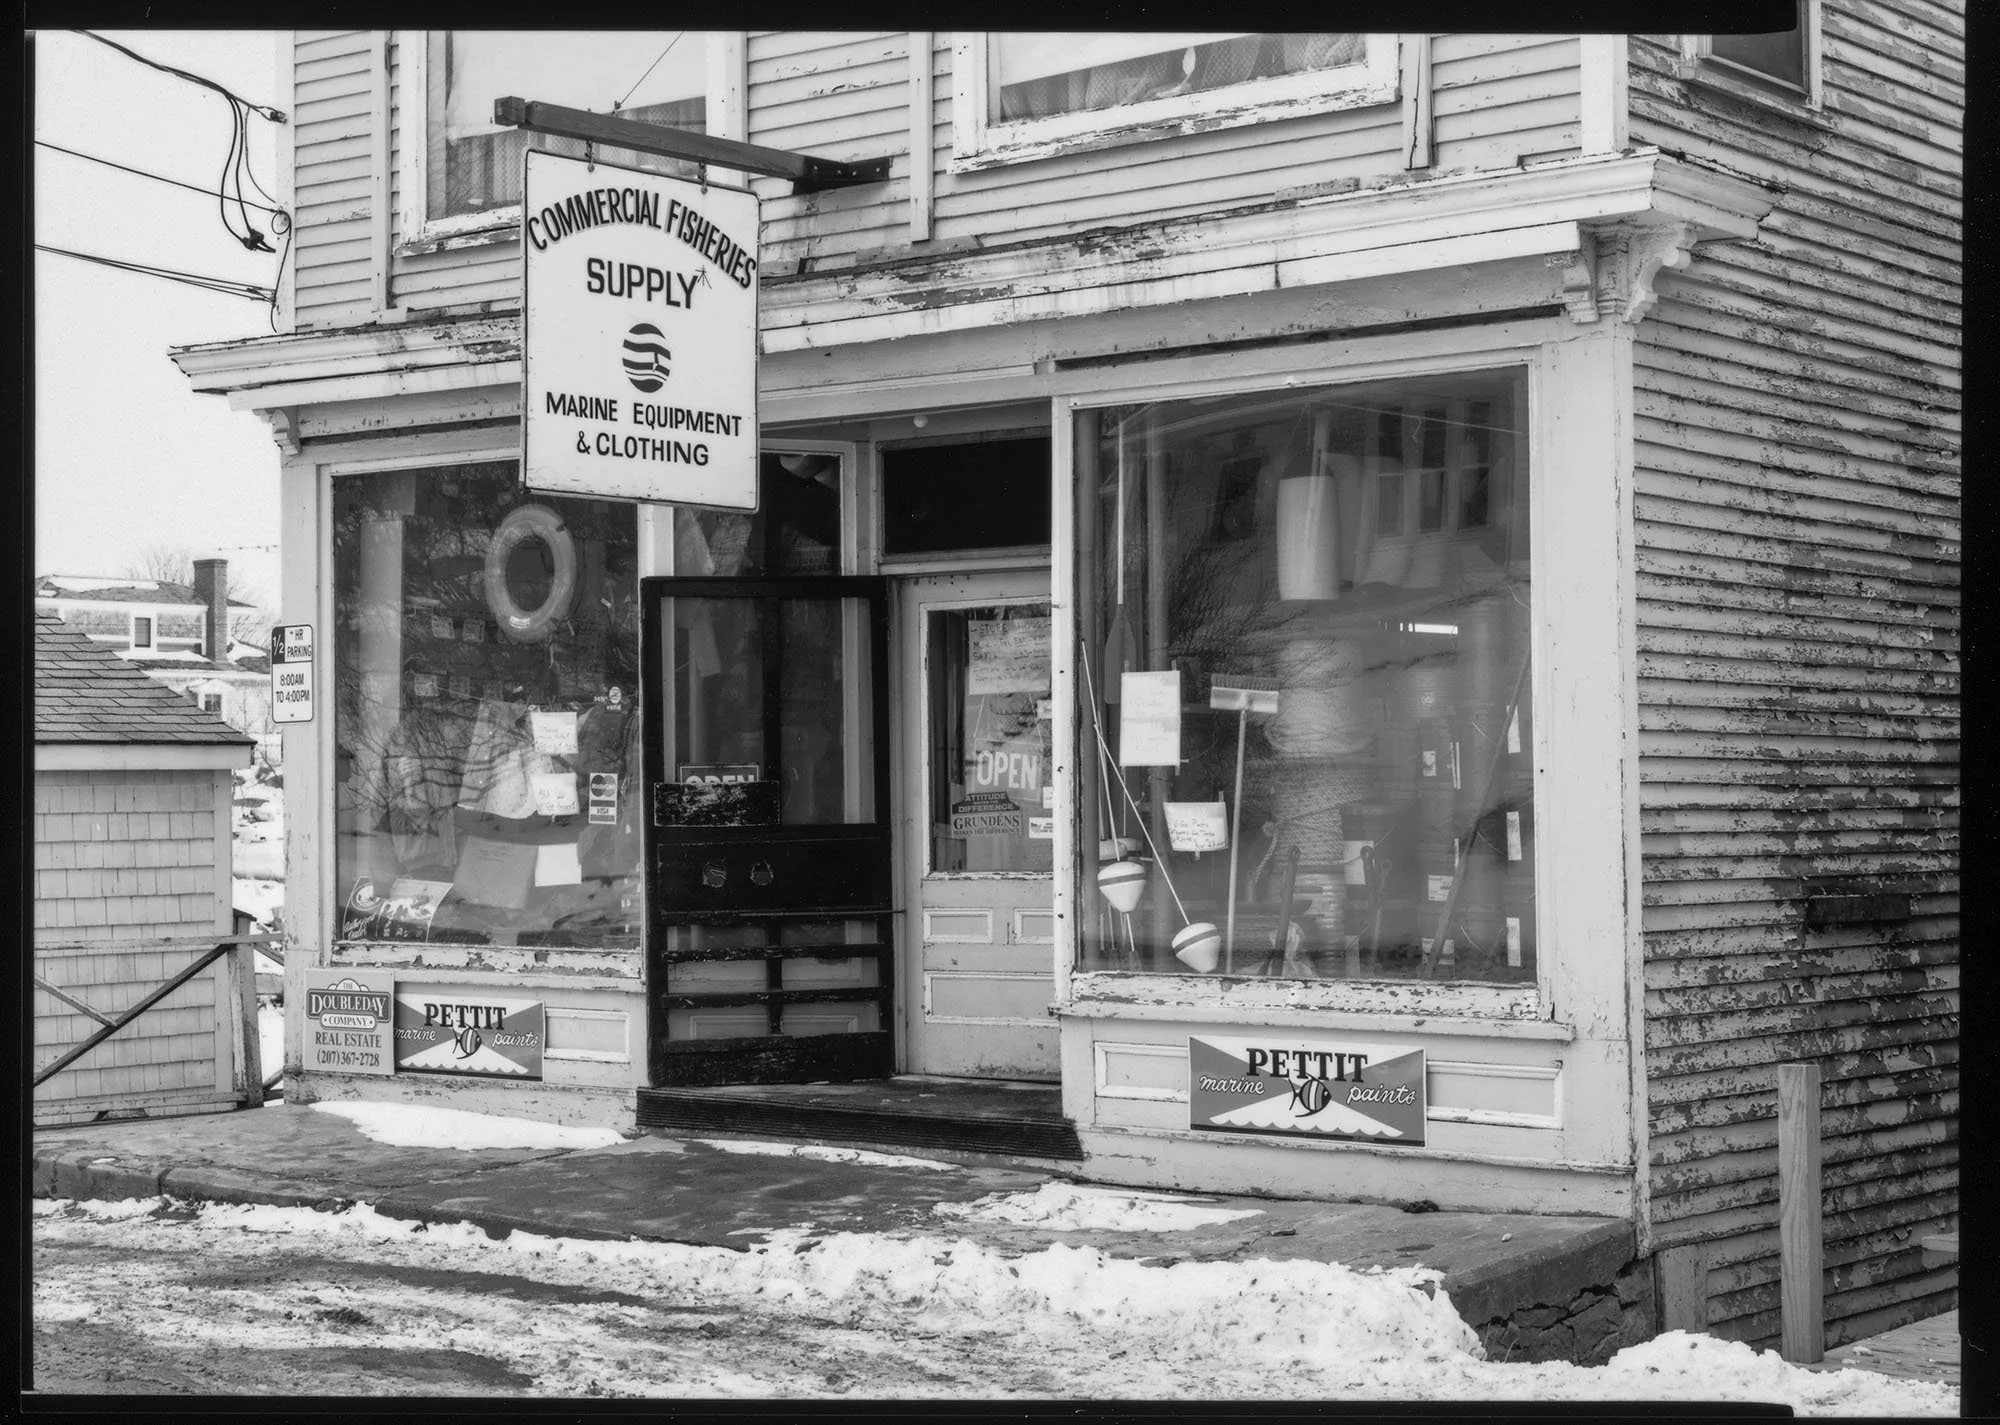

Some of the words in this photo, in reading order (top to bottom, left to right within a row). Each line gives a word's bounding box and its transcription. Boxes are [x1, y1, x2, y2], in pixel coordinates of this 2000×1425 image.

[528, 187, 662, 251] COMMERCIAL
[665, 199, 757, 290] FISHERIES
[587, 258, 699, 309] SUPPLY
[546, 391, 618, 422] MARINE
[633, 403, 742, 437] EQUIPMENT
[576, 430, 591, 455] &
[596, 432, 709, 467] CLOTHING
[294, 628, 304, 641] HR
[287, 645, 312, 657] PARKING
[276, 691, 284, 703] TO
[977, 751, 1038, 791] OPEN
[958, 803, 1014, 813] DIFFERENCE
[964, 792, 1008, 802] ATTITUDE
[310, 994, 386, 1018] DOUBLEDAY
[424, 1003, 507, 1030] PETTIT
[329, 1016, 368, 1026] COMPANY
[315, 1031, 342, 1046] REAL
[344, 1033, 382, 1049] ESTATE
[394, 1026, 437, 1042] marine
[492, 1031, 539, 1048] paints
[1246, 1048, 1368, 1083] PETTIT
[1199, 1075, 1265, 1095] marine
[1346, 1084, 1416, 1105] paints
